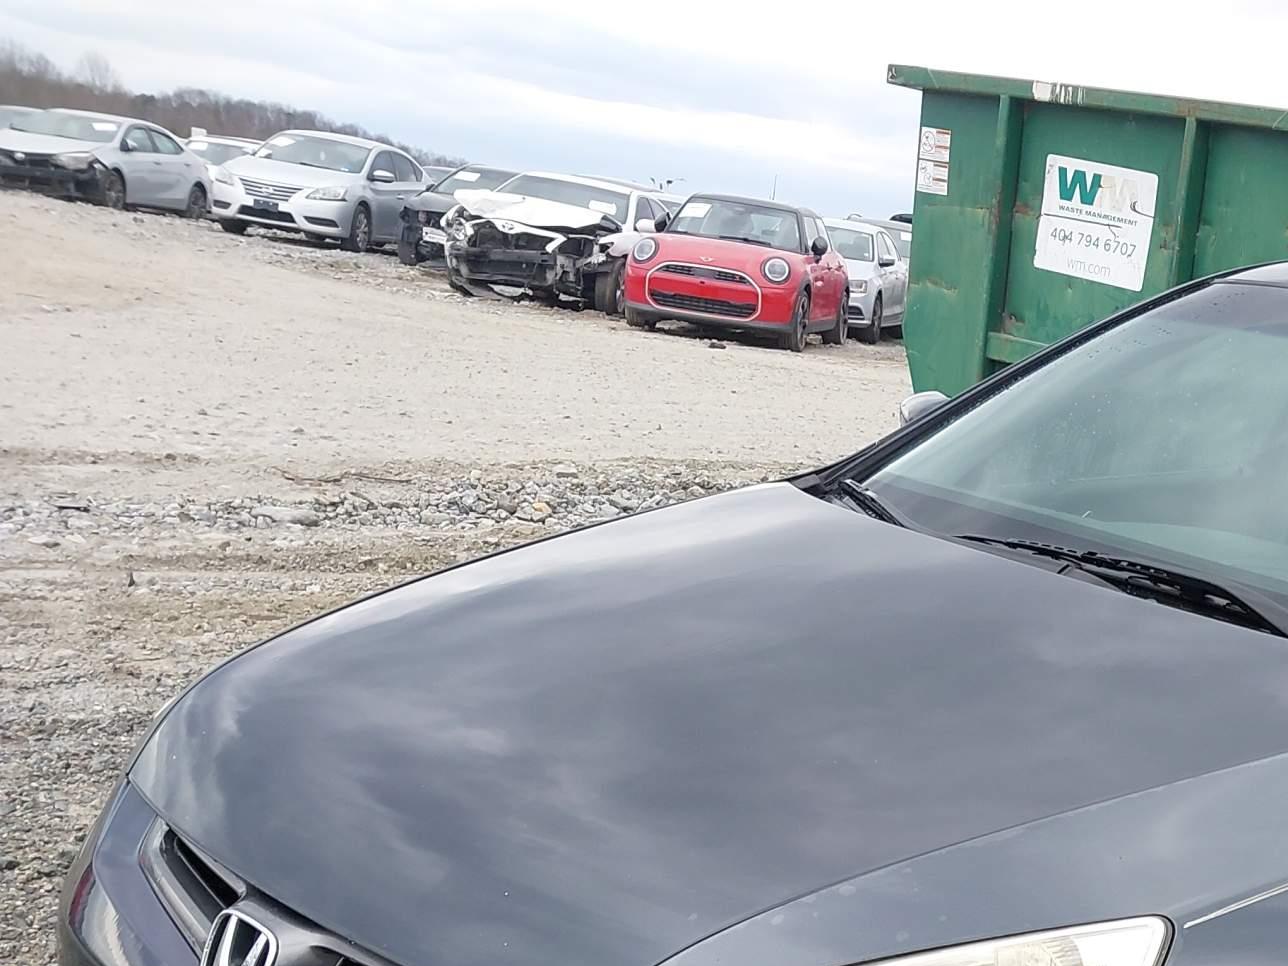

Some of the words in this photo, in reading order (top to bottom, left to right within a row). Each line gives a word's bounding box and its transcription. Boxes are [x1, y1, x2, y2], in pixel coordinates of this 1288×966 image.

[1059, 205, 1083, 215] WASTE
[1085, 210, 1138, 227] MANAGEMENT
[1050, 227, 1073, 243] 404
[1077, 232, 1100, 249] 794
[1103, 238, 1137, 258] 6707
[1067, 258, 1111, 278] wm.com
